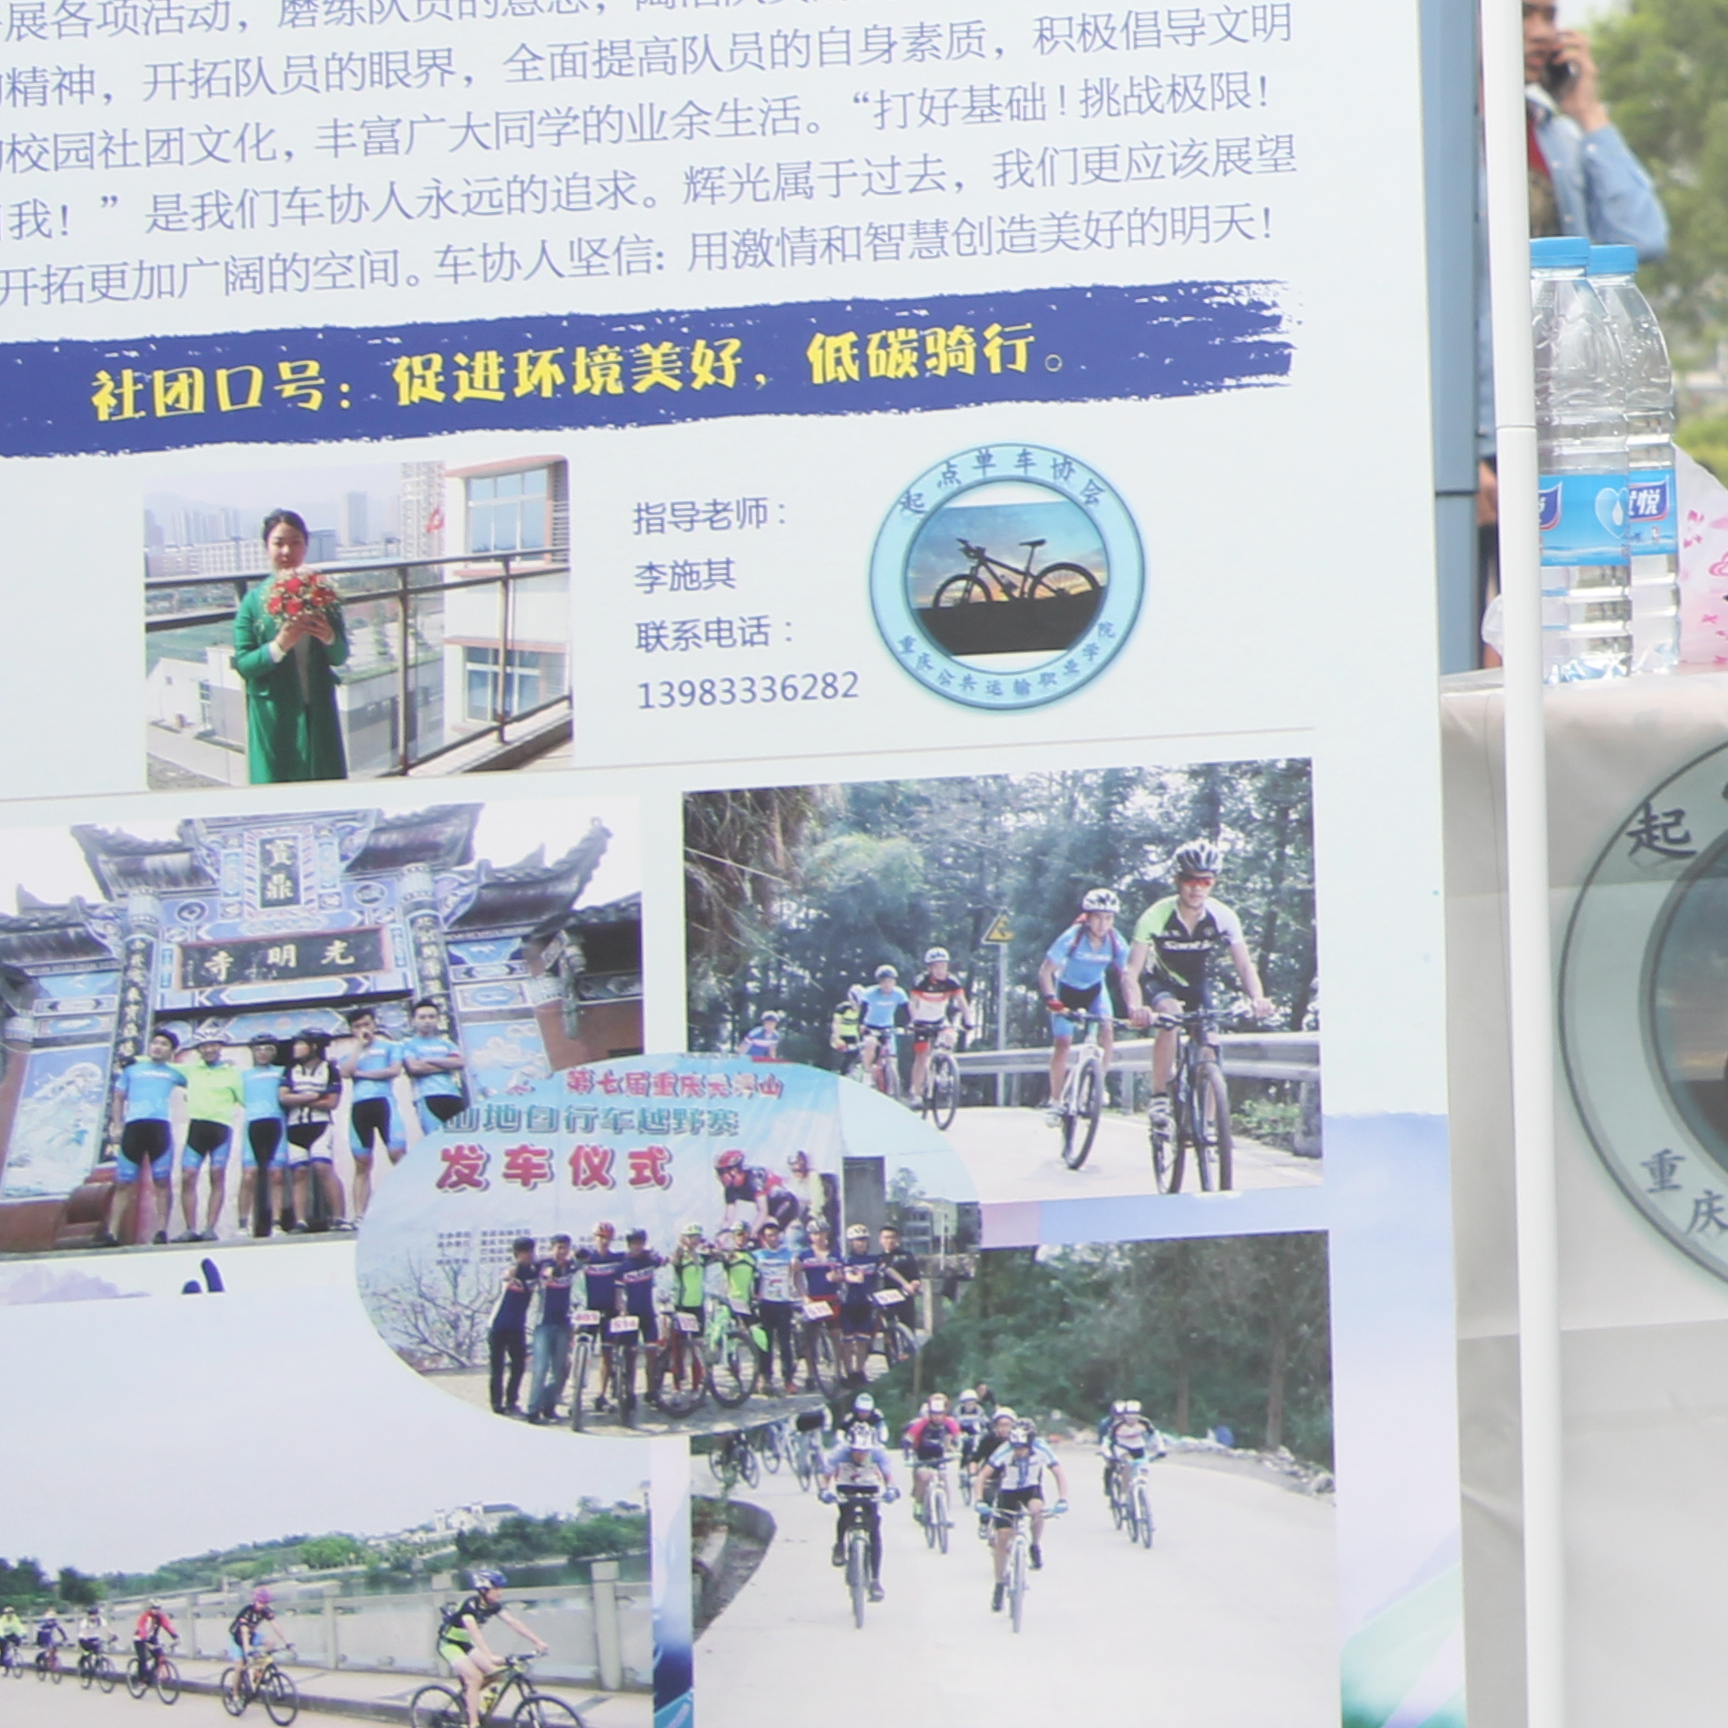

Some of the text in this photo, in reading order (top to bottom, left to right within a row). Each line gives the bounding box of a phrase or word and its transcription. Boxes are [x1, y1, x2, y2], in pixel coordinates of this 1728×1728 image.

[0, 4, 1291, 106] 精神，开拓队员的眼界，全面提高队员的自身素质，积极倡导文明
[0, 72, 1266, 172] 校园社团文化，丰富广大同学的业余生活。“打好基础！挑战极限！
[0, 135, 1297, 238] 我！”是我们车协人永远的追求。辉光属于过去，我们更应该展望
[899, 447, 1106, 516] 起点单车协会
[633, 498, 787, 536] 指导老师：
[634, 557, 737, 595] 李施其
[635, 615, 794, 654] 联系电话：
[899, 621, 1115, 697] 重庆公共运输职业学院
[637, 671, 859, 710] 13983336282
[436, 1143, 676, 1194] 发车仪式
